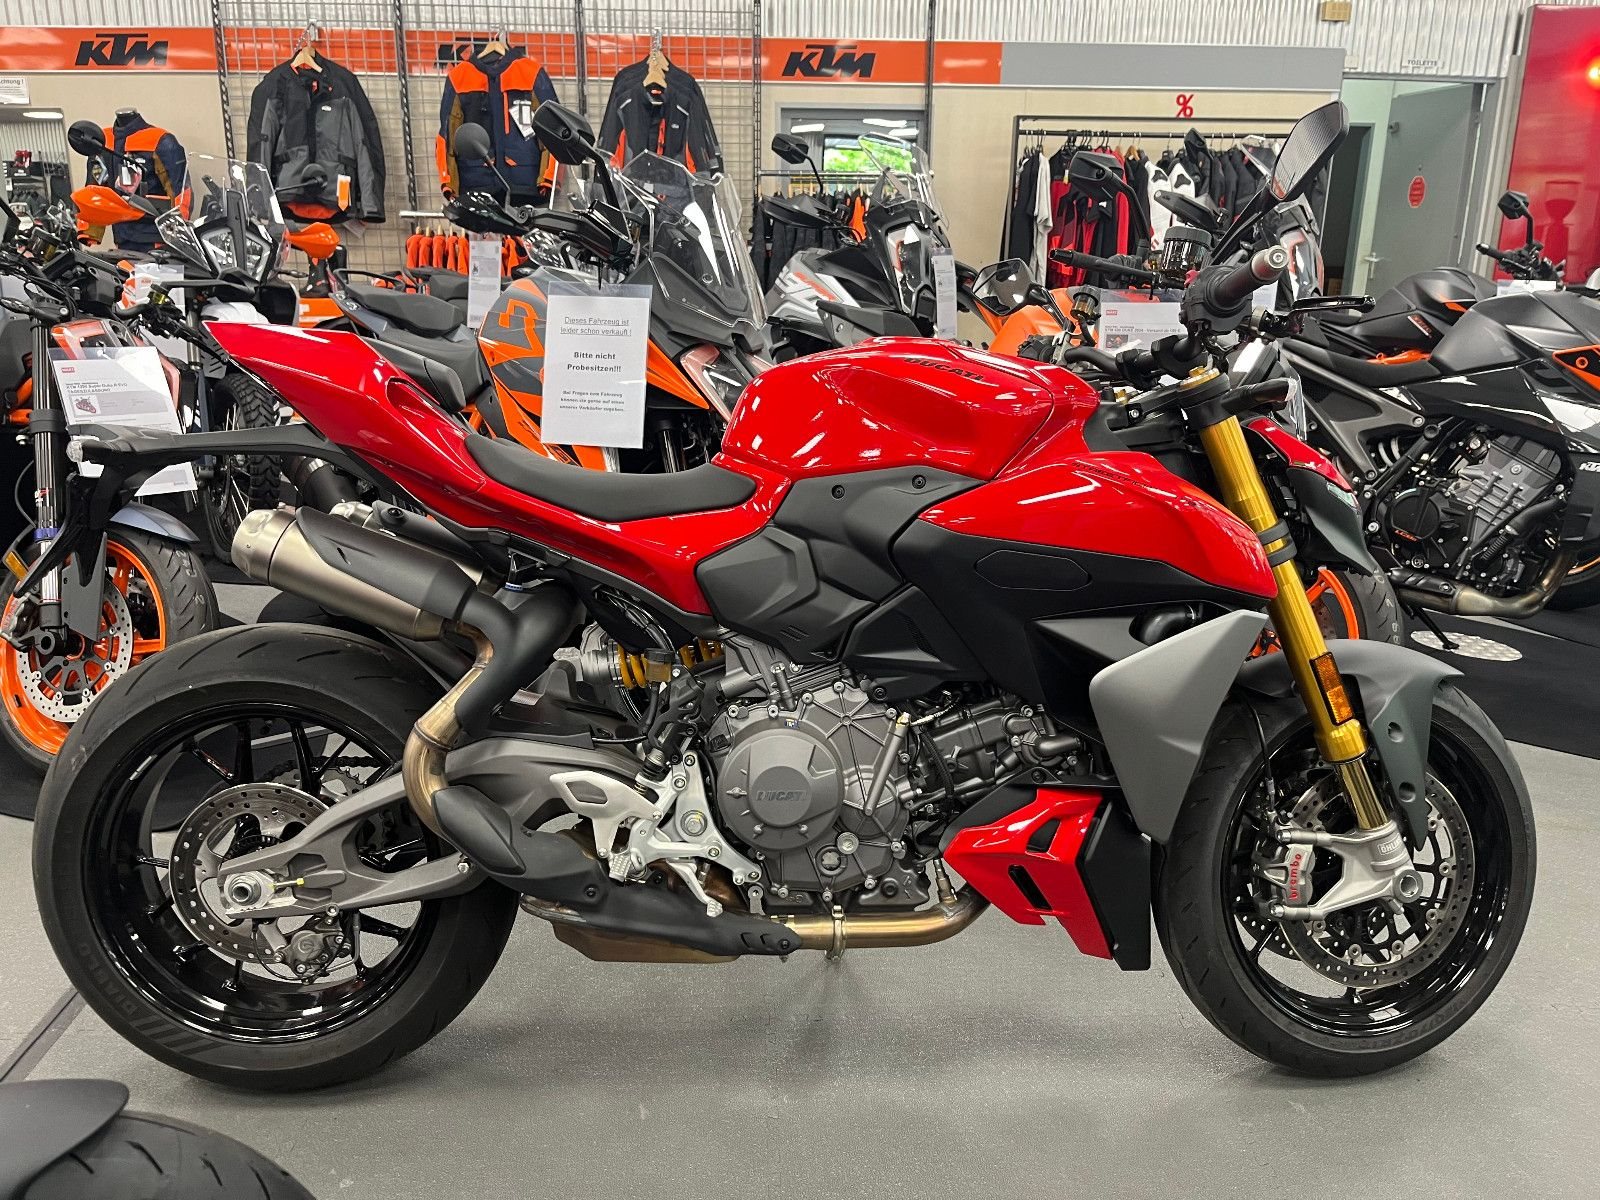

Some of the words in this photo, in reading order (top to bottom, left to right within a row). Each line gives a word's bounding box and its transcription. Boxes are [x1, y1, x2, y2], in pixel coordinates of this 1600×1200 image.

[75, 33, 169, 65] KTM
[782, 45, 876, 78] KTM
[588, 317, 620, 326] Fahrzeug
[580, 327, 600, 335] schon
[595, 352, 616, 360] nicht
[567, 363, 622, 373] Probesitzen!!!
[904, 358, 984, 381] DUCATI
[1288, 853, 1302, 900] brembo
